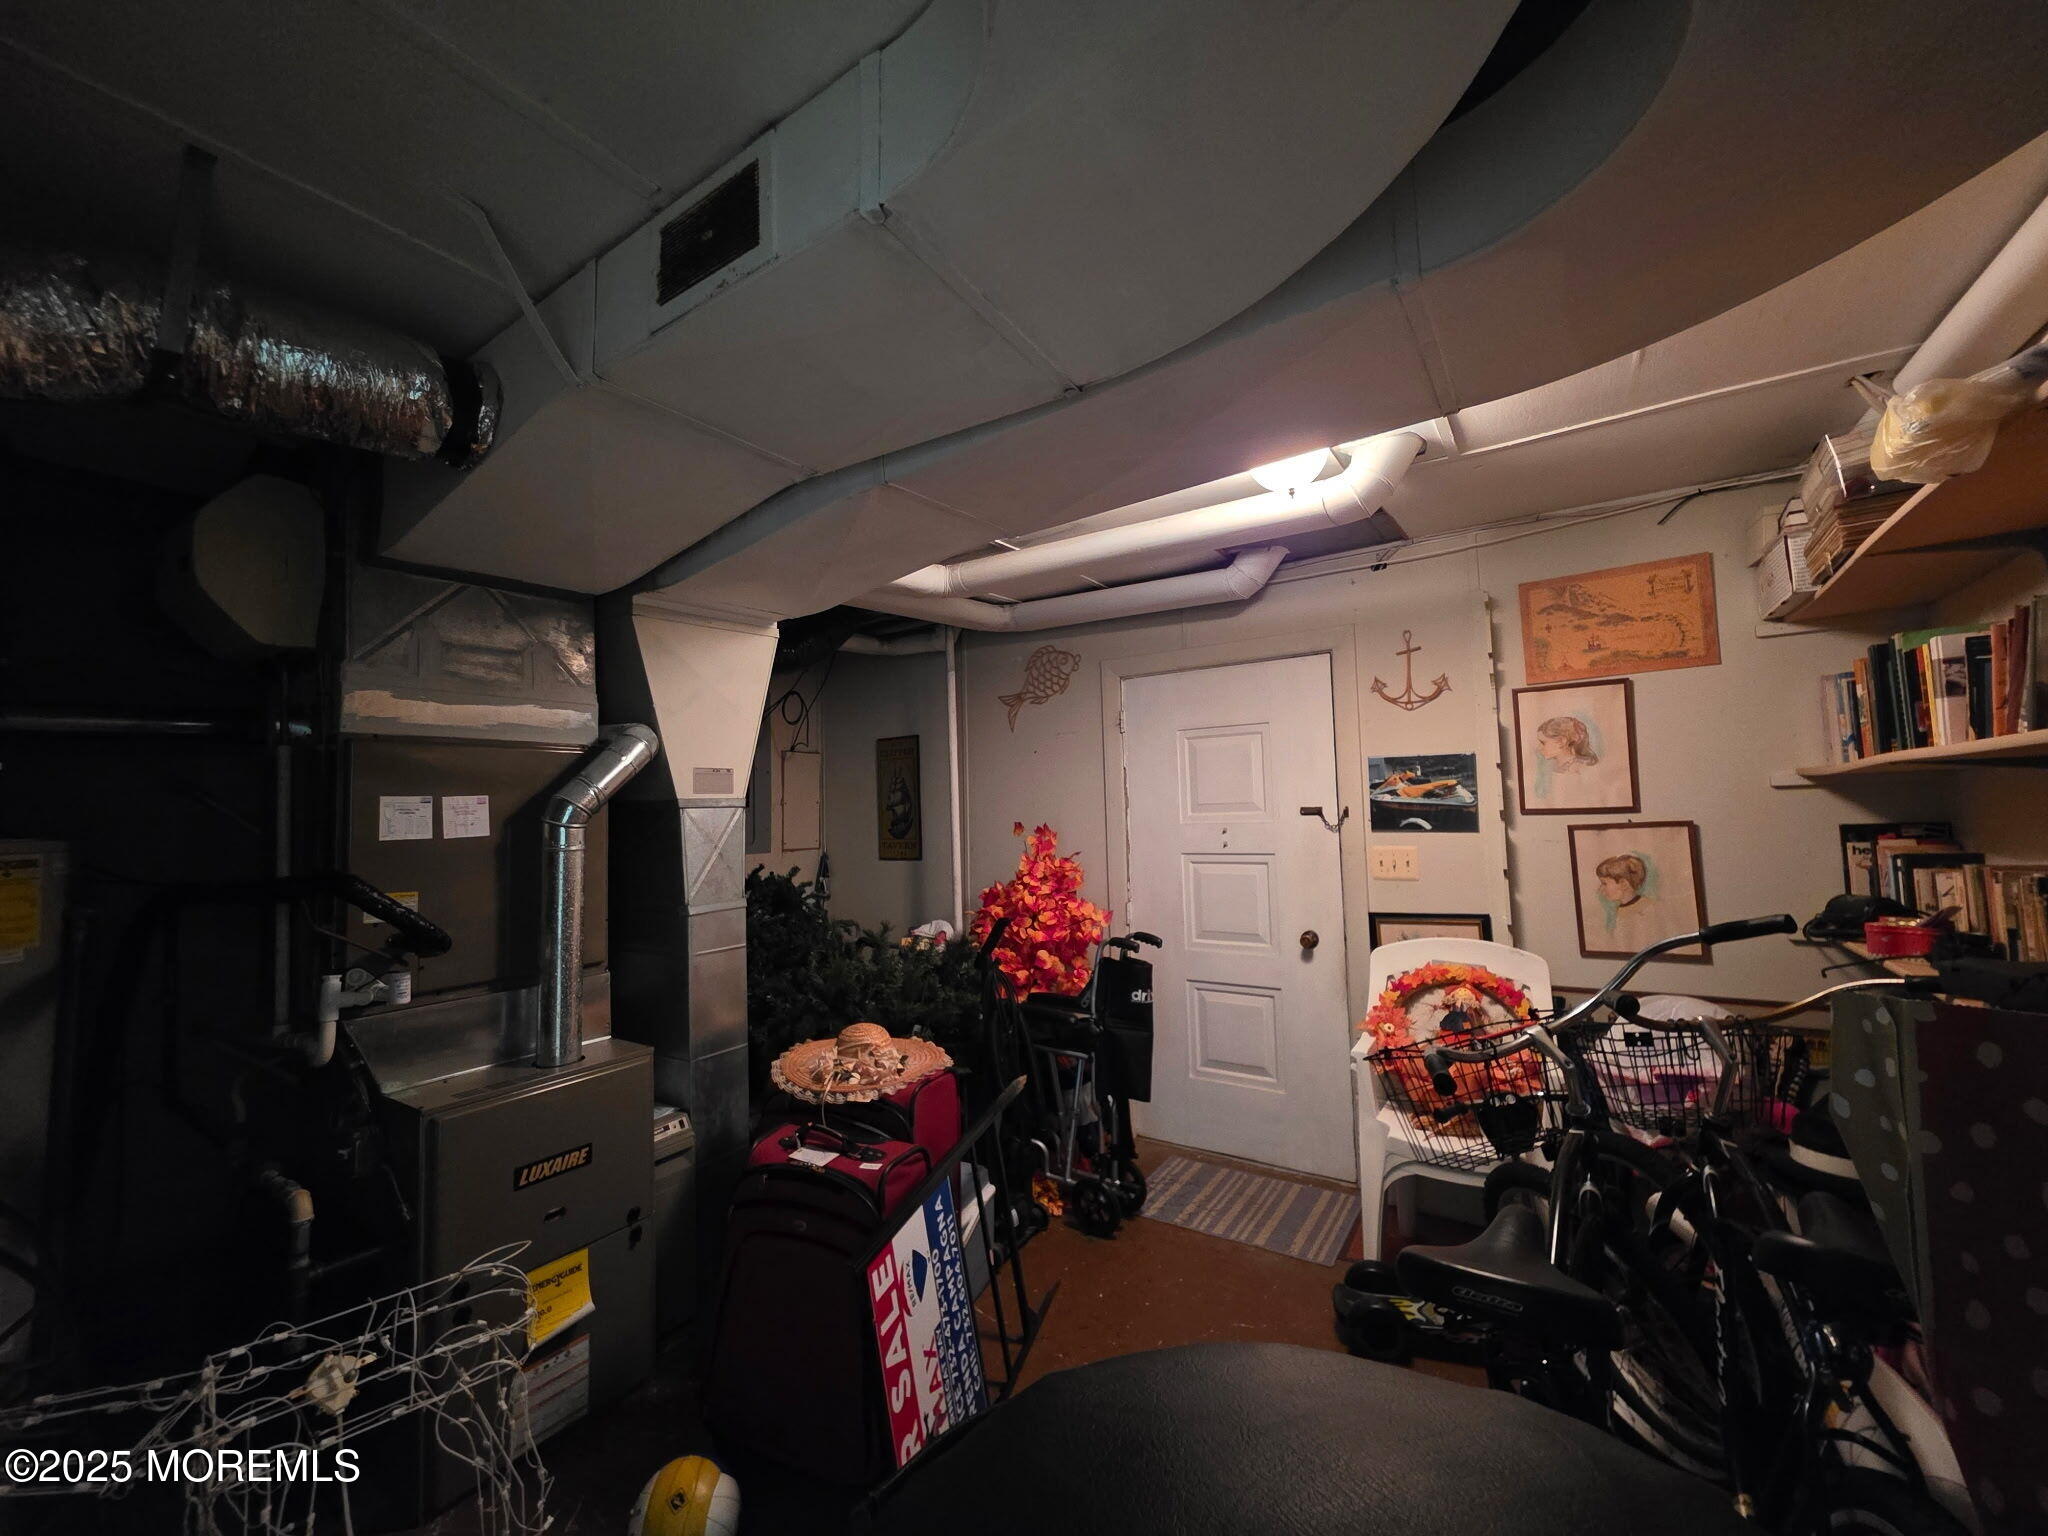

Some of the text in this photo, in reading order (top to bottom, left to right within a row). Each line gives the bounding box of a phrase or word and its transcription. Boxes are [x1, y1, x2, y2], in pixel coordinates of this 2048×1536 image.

[1131, 989, 1152, 1002] dri
[519, 1147, 590, 1186] LUXAIRE
[934, 1194, 977, 1417] RENDA CAMPAGNA
[871, 1253, 912, 1414] SALE
[954, 1383, 966, 1422] ICE
